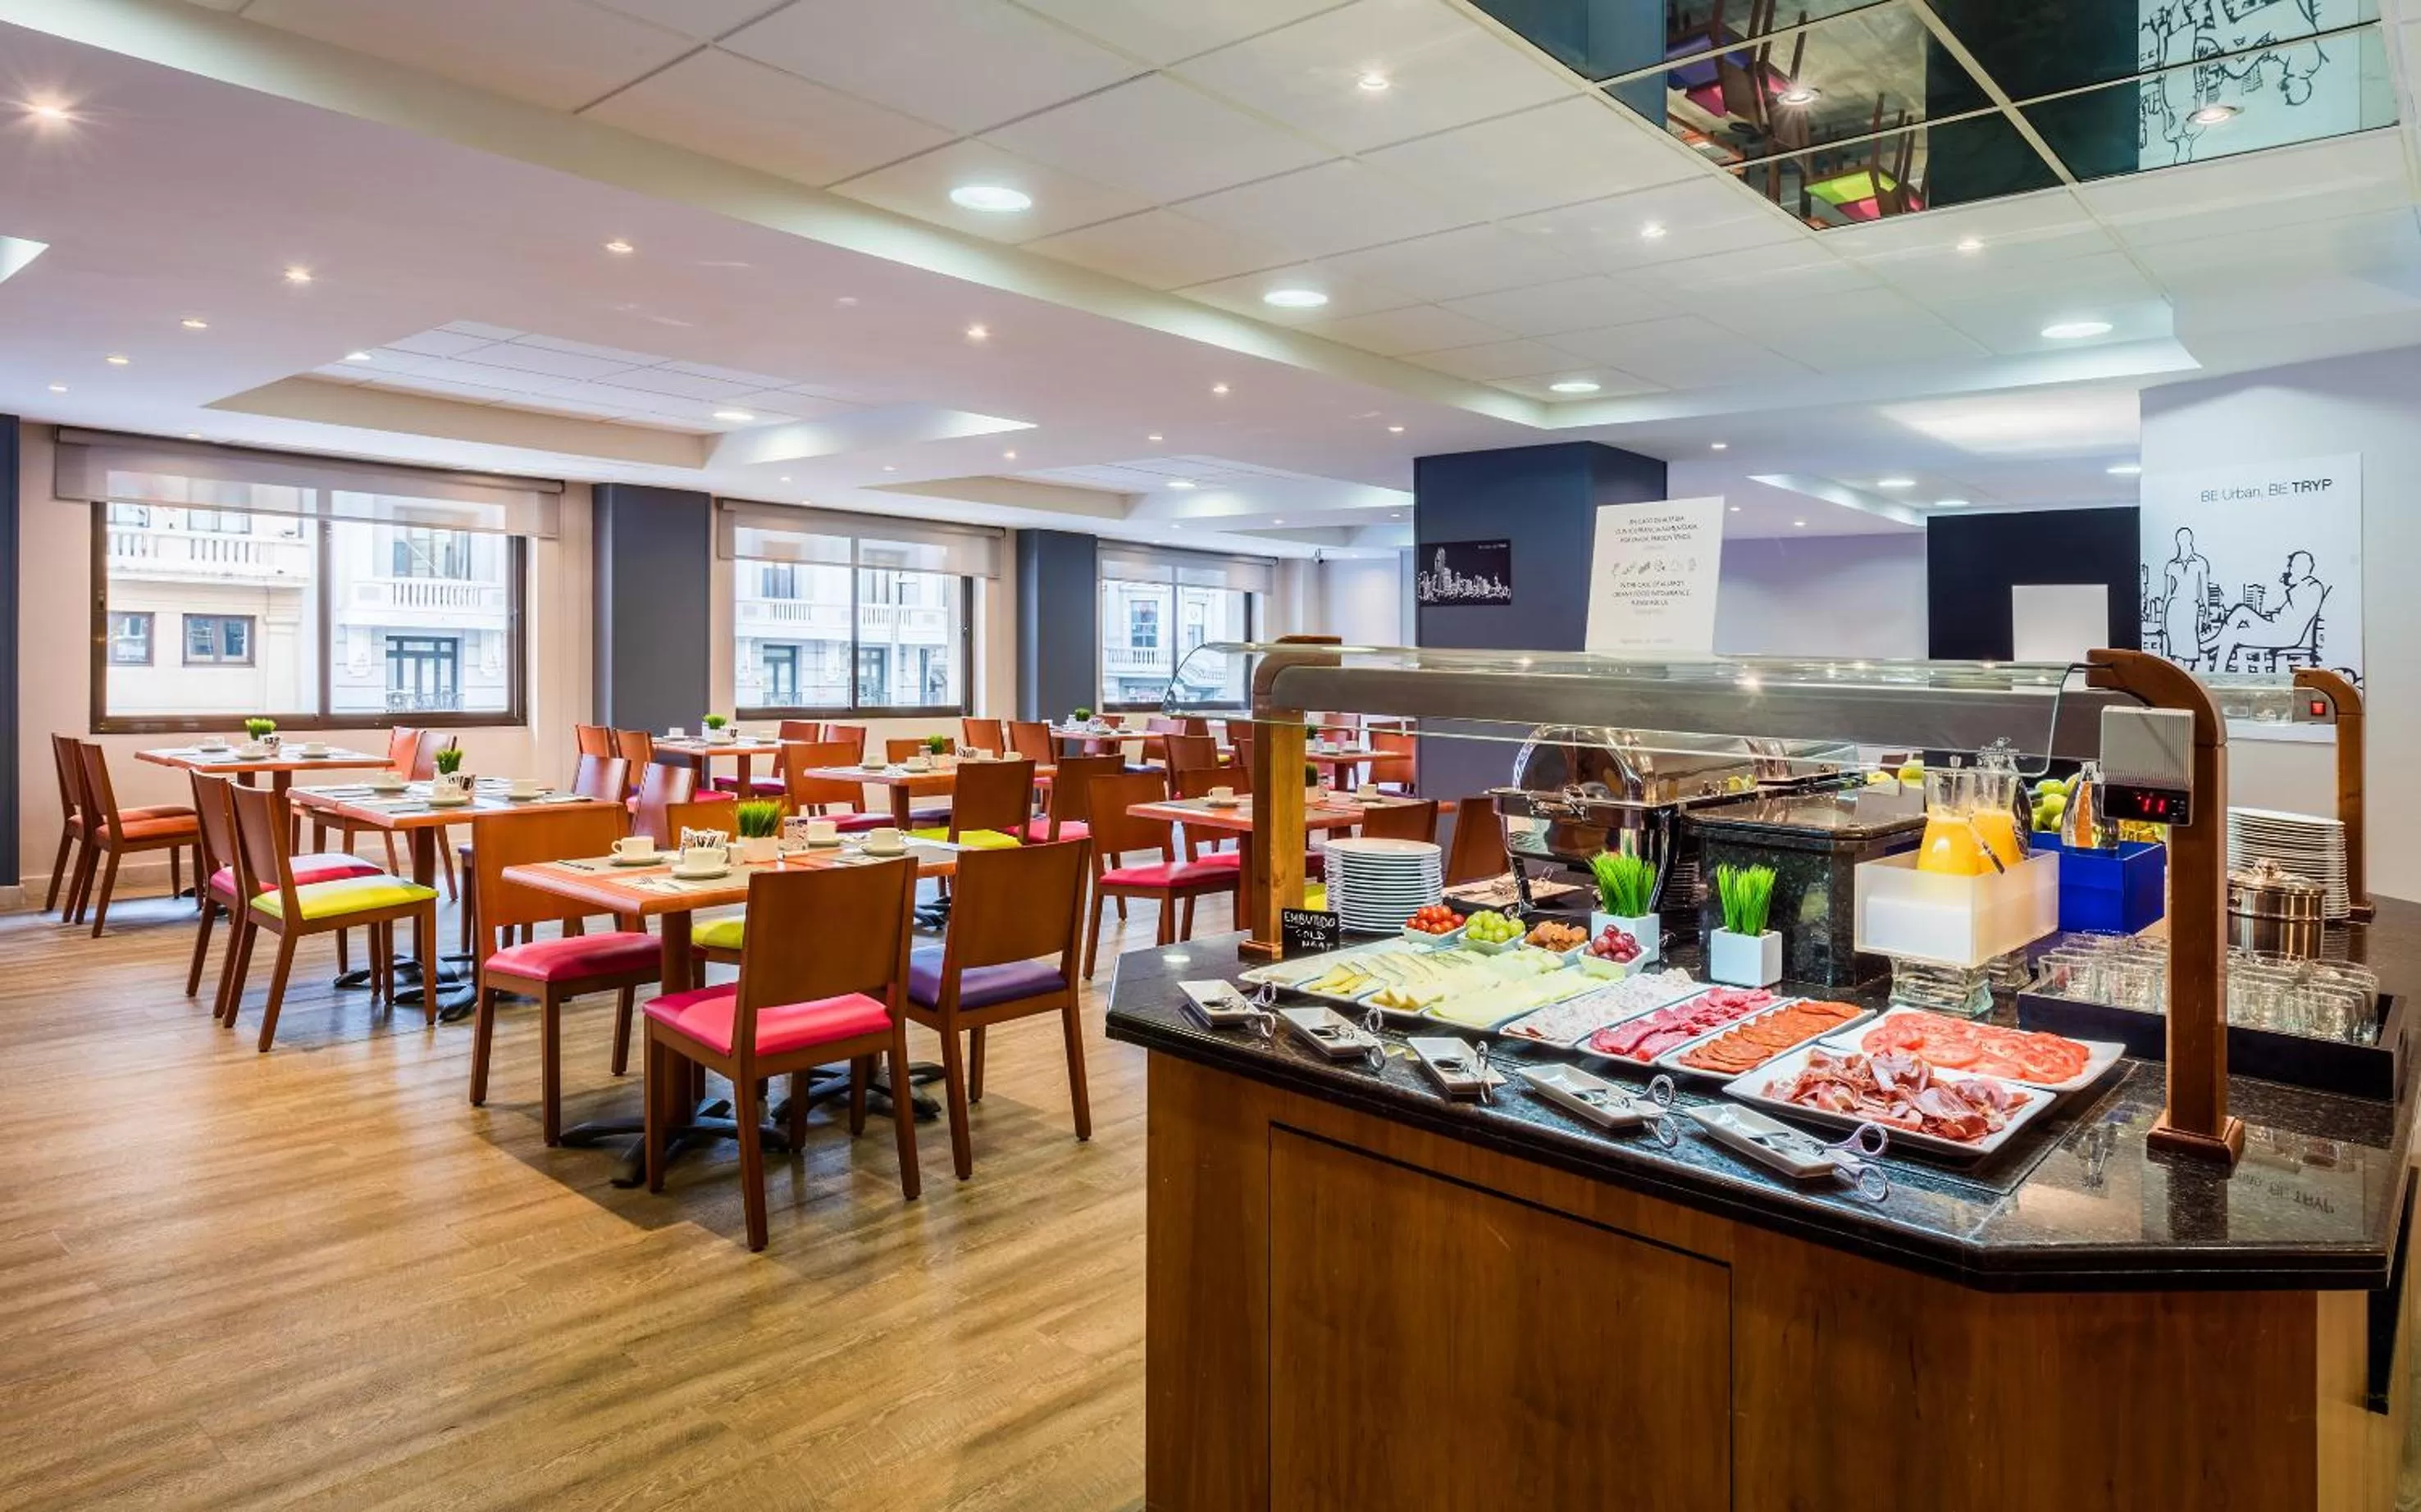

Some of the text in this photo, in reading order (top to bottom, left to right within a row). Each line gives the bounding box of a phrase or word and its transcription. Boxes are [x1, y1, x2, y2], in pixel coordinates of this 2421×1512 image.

[2200, 478, 2333, 503] BE Urban, BE TRYP
